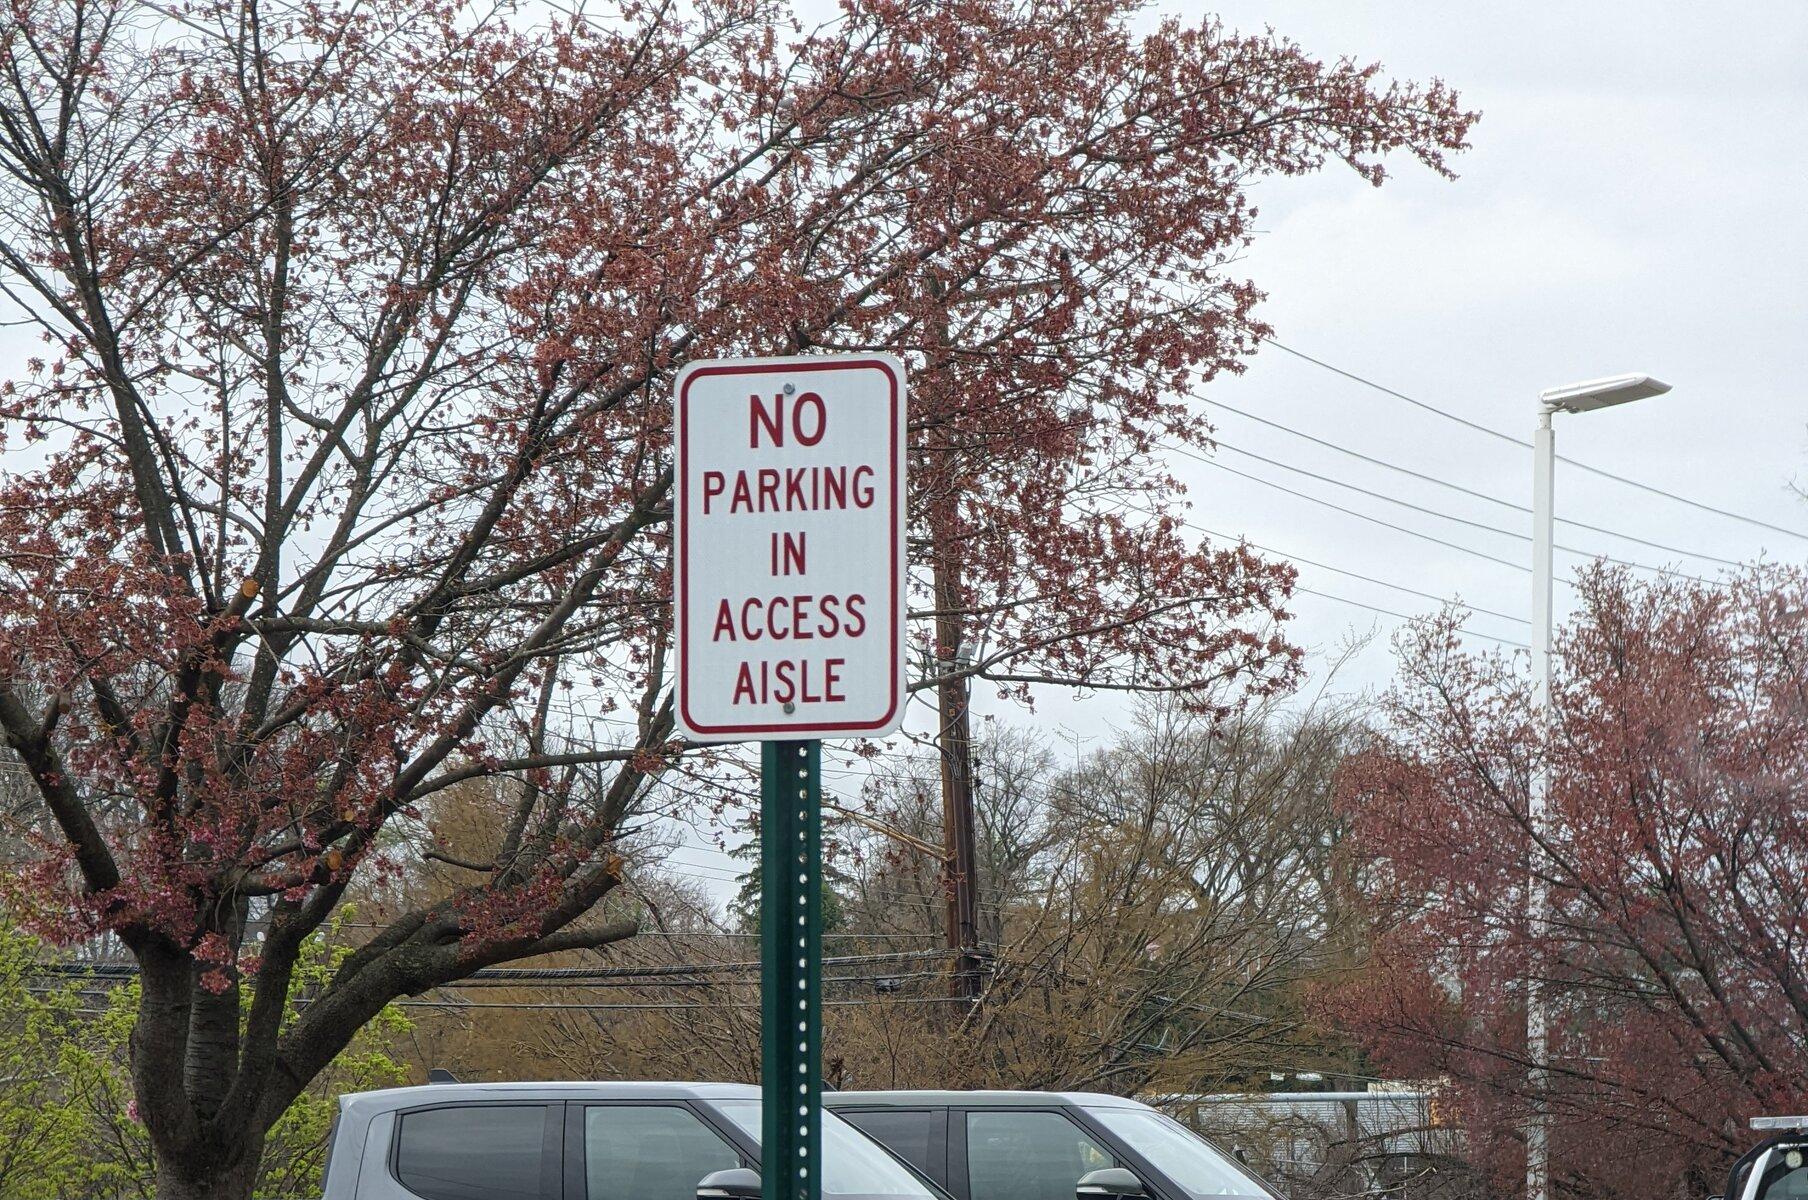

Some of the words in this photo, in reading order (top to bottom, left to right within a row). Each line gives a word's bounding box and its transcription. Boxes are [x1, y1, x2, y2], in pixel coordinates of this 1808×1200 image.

[750, 391, 827, 448] NO
[703, 464, 875, 515] PARKING
[771, 531, 806, 576] IN
[713, 594, 866, 642] ACCESS
[732, 658, 846, 705] AISLE
